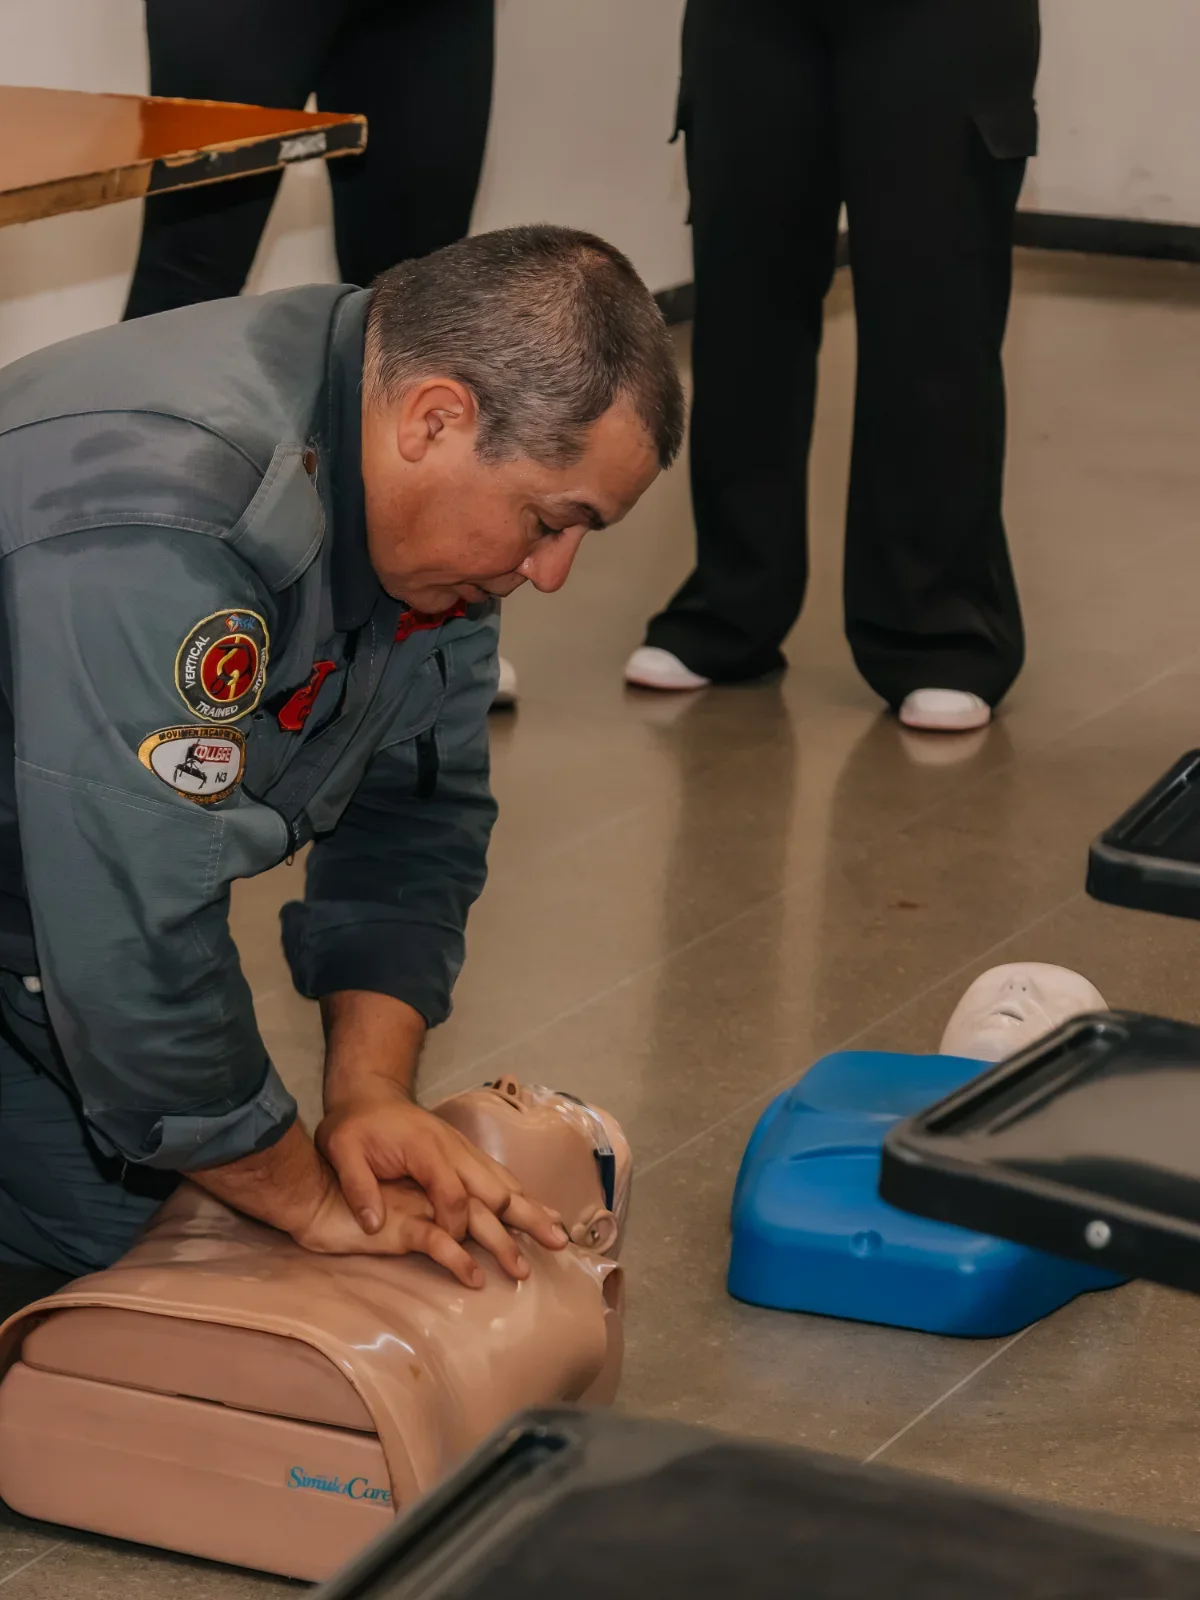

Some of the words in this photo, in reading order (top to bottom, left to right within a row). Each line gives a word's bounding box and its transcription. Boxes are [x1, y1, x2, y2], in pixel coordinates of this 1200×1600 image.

[185, 636, 211, 689] VERTICAL
[196, 701, 239, 718] TRAINED
[194, 744, 232, 763] COLLEGE
[215, 772, 227, 784] N3
